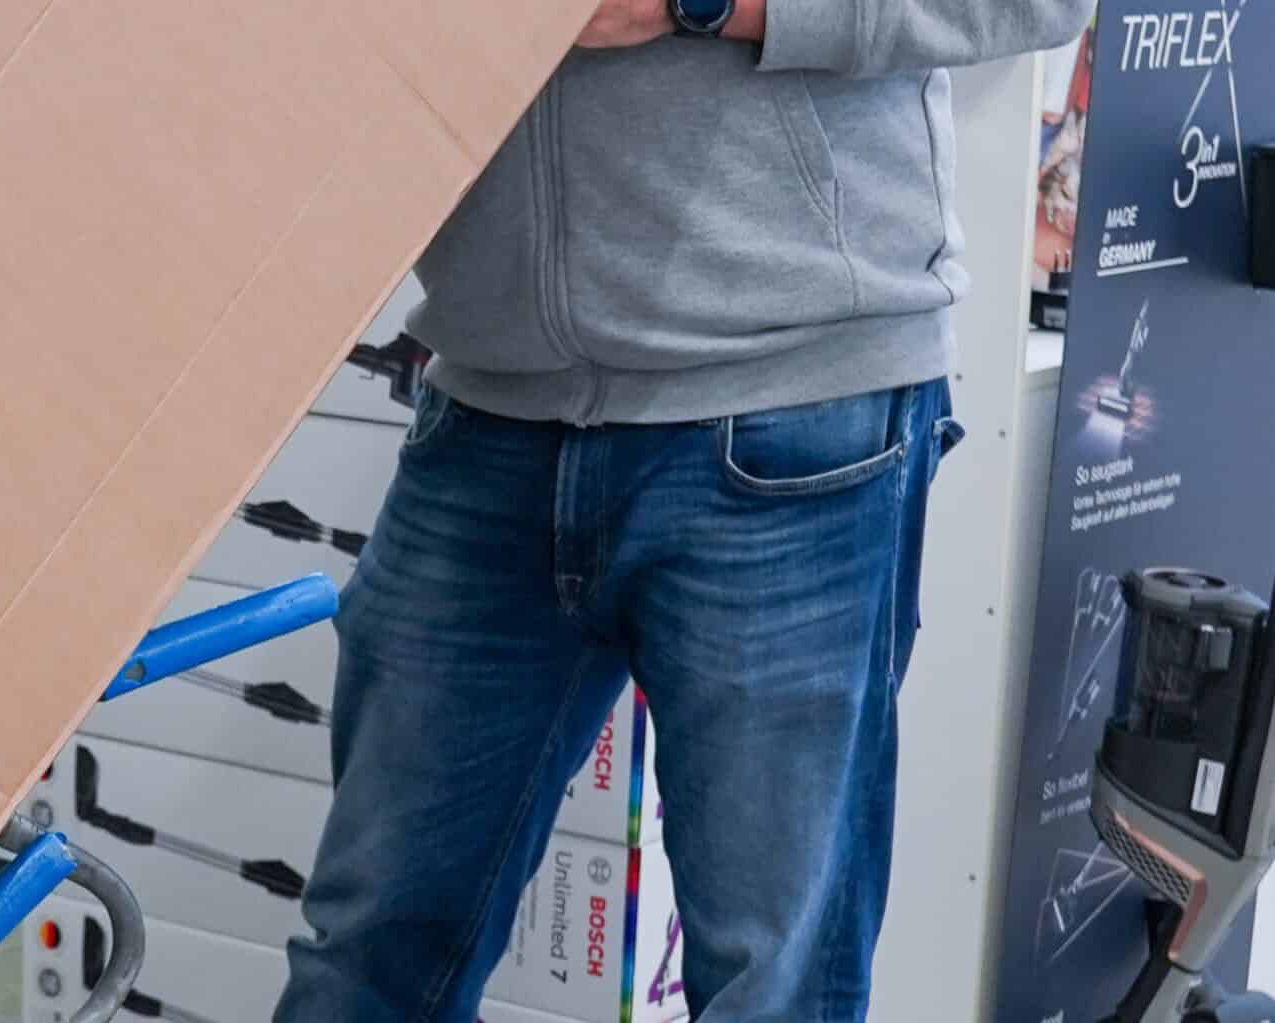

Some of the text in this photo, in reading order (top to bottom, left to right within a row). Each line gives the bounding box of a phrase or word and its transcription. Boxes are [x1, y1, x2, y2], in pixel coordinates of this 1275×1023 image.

[1121, 10, 1240, 72] TRIFLEX
[1105, 205, 1139, 228] MADE
[1099, 239, 1156, 268] GERMANY
[594, 710, 613, 791] OSCH
[550, 851, 573, 984] Unlimited 7
[587, 895, 607, 977] BOSCH
